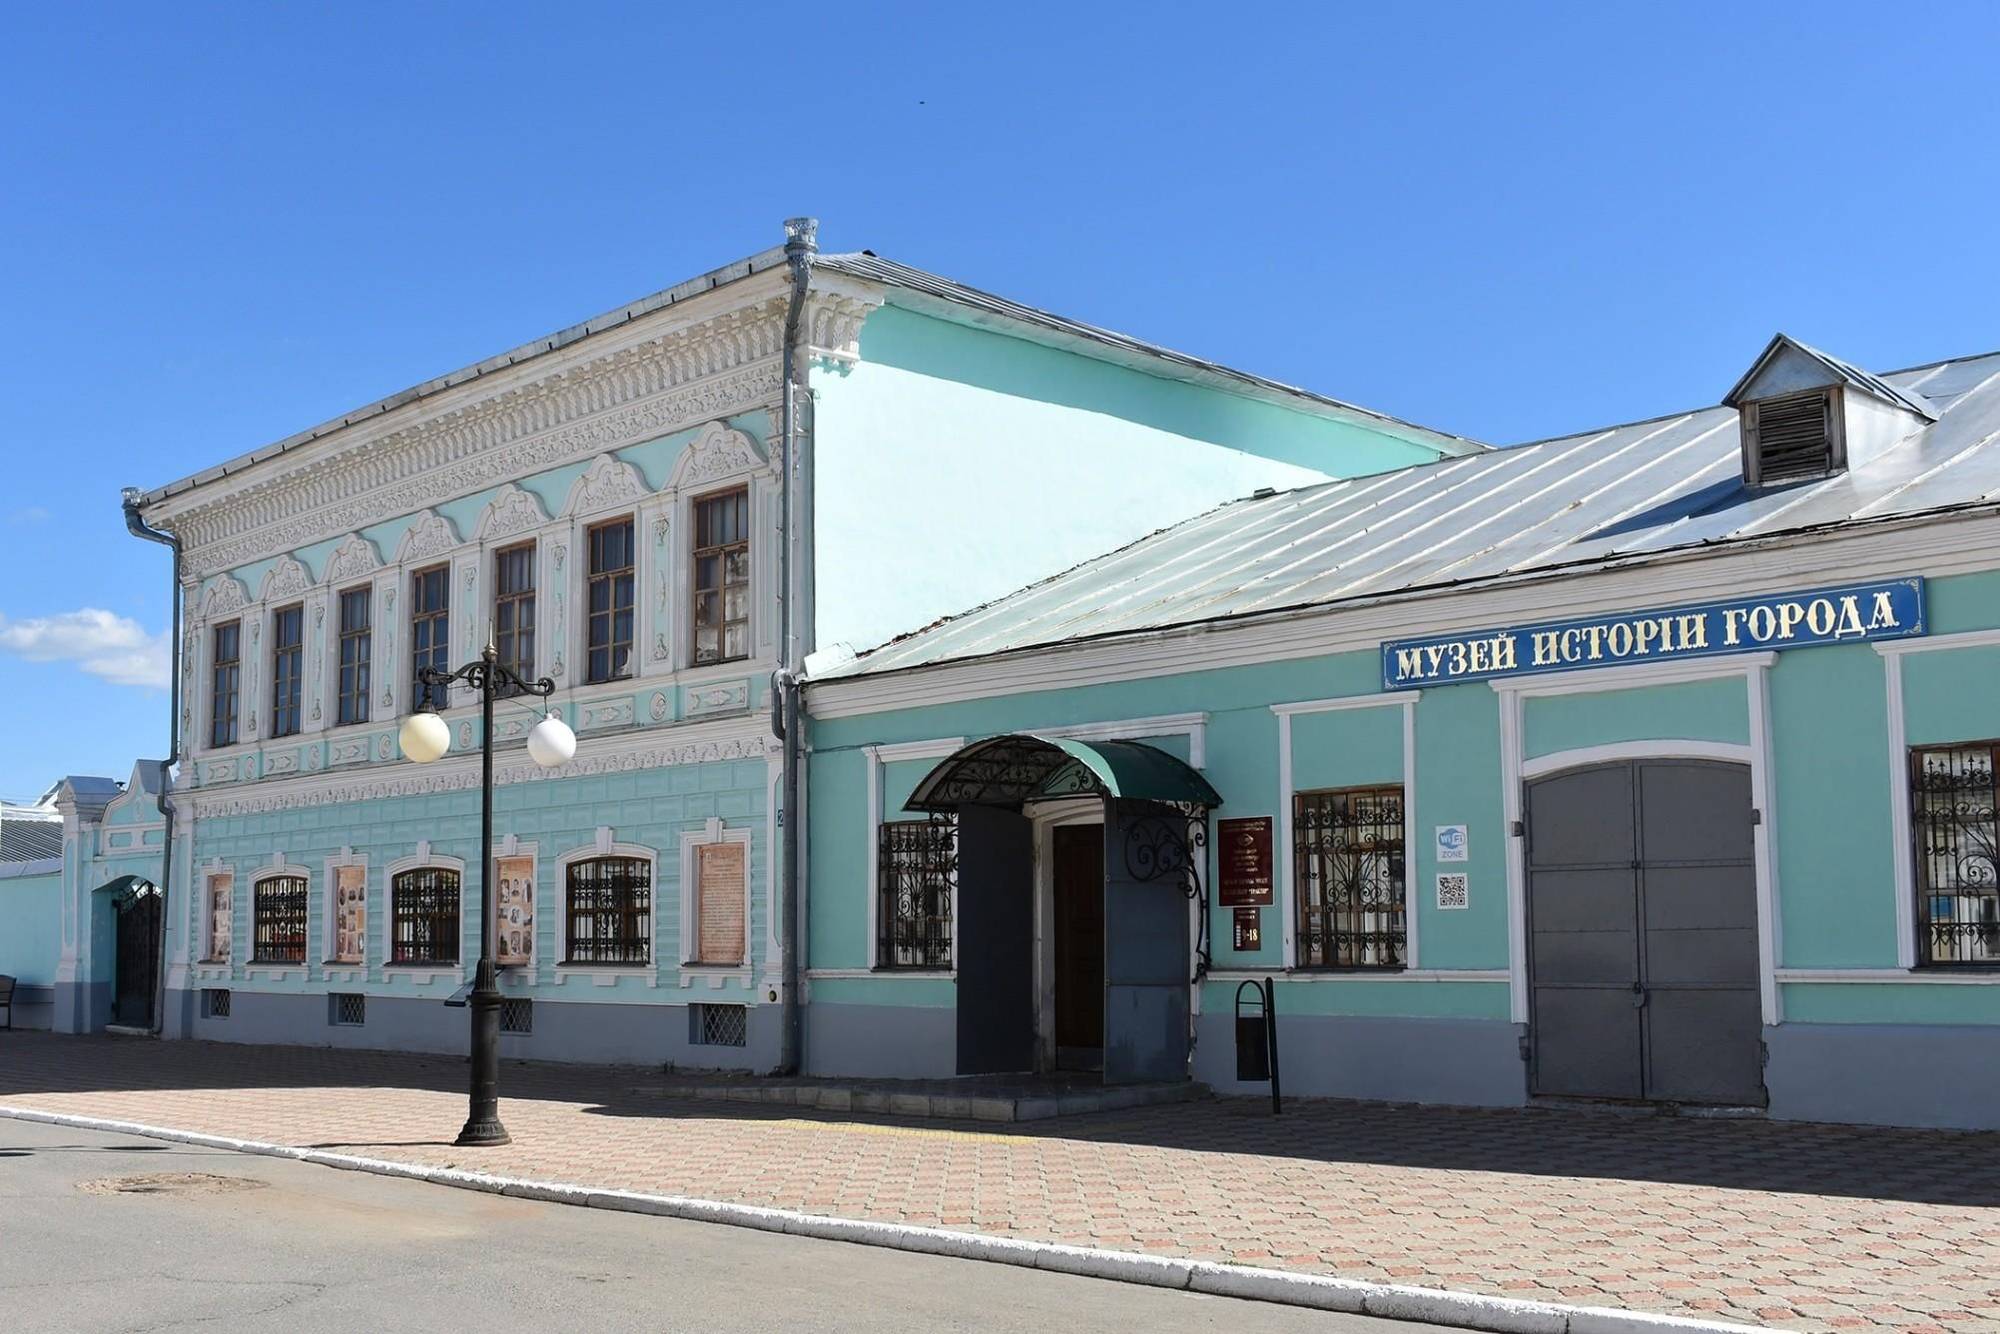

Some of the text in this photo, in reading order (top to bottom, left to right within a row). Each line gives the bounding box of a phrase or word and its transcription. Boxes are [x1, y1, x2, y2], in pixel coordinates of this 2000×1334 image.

[1395, 591, 1900, 681] МУЗЕЙ ИСТОРІИ ГОРОДА
[1442, 850, 1463, 858] ZONE
